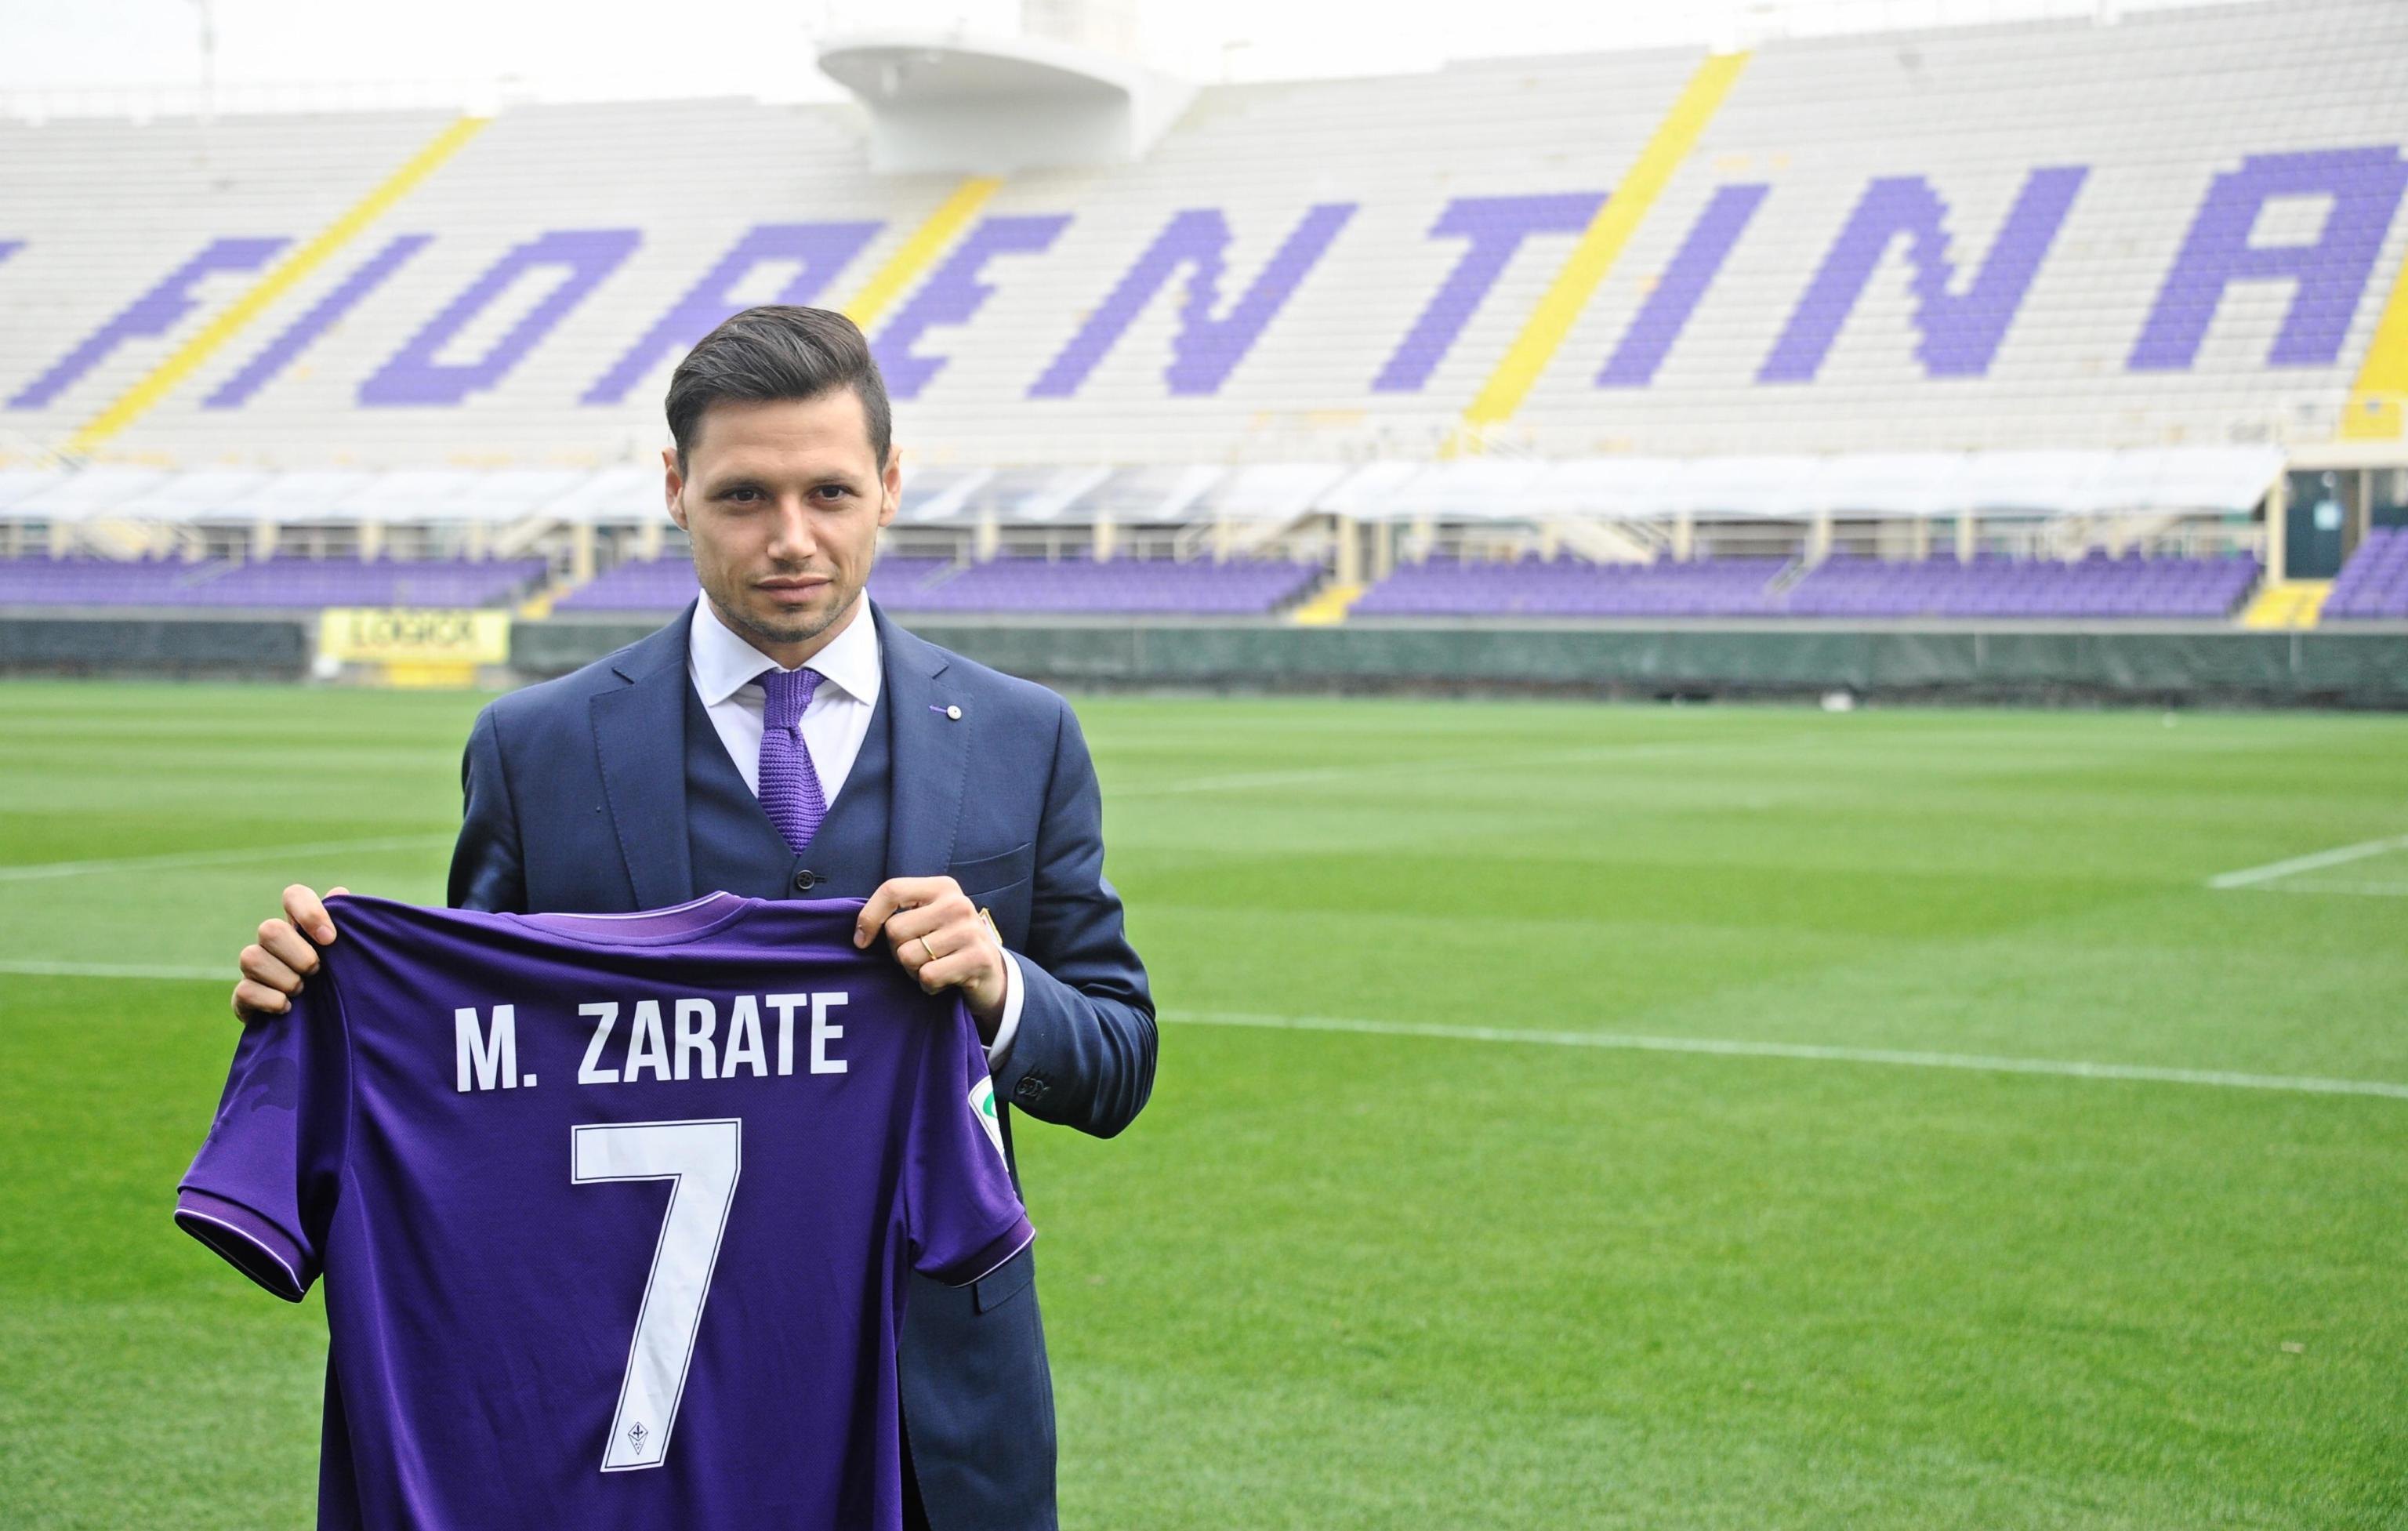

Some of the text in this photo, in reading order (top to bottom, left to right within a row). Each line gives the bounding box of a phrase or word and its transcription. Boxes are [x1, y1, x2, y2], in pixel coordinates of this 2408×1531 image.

[9, 146, 2408, 408] FIORENTINA
[455, 992, 849, 1092] M. ZARATE
[571, 1118, 742, 1473] 7
